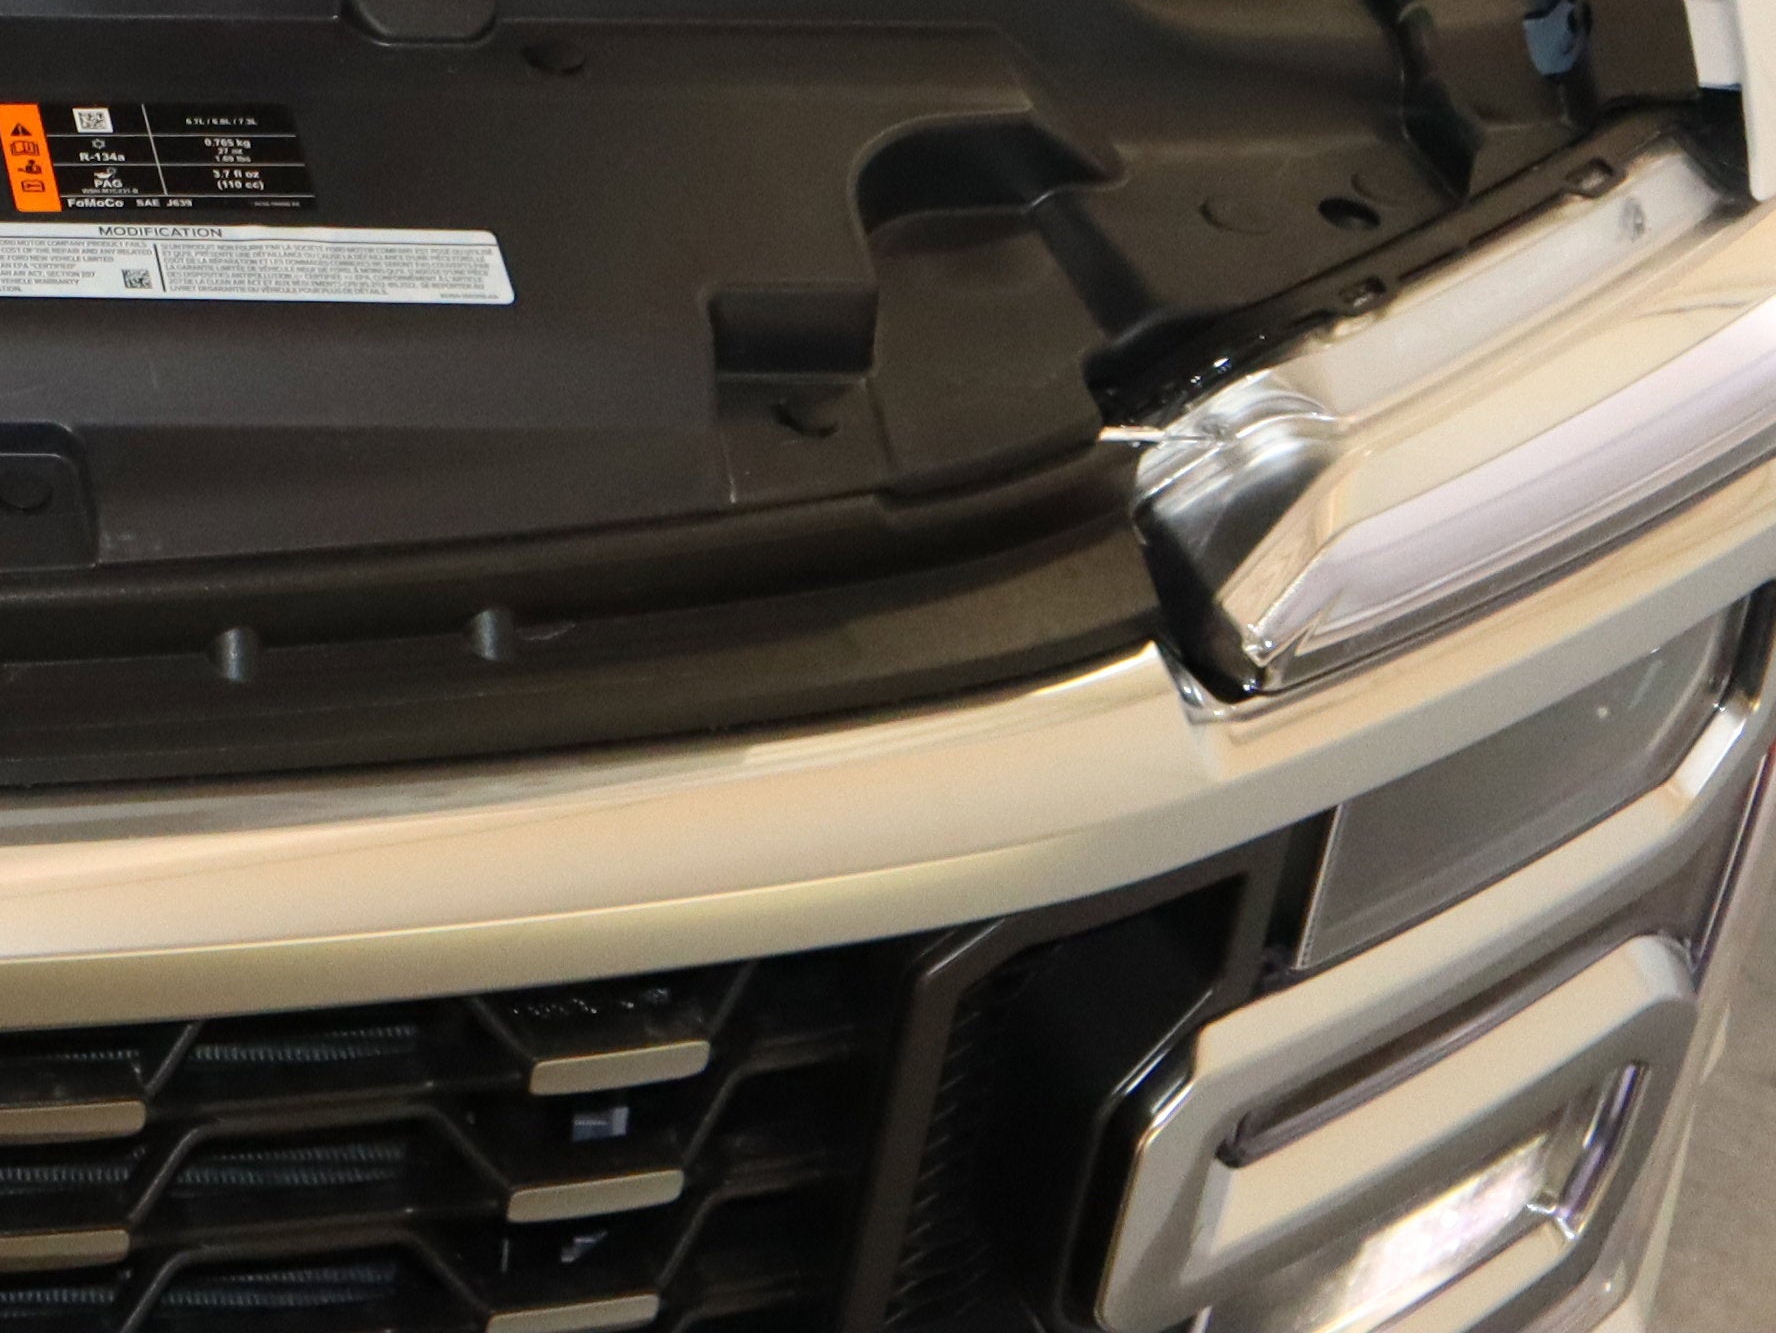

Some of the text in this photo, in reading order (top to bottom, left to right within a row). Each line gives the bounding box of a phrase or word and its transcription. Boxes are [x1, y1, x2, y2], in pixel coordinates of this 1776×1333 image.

[235, 139, 252, 149] kg
[79, 152, 126, 161] R-134a
[213, 169, 231, 179] 3.7
[93, 179, 123, 188] PAG
[217, 180, 243, 191] (110
[67, 198, 124, 207] FoMoCo
[136, 199, 161, 207] SAE
[98, 225, 223, 238] MODIFICATION
